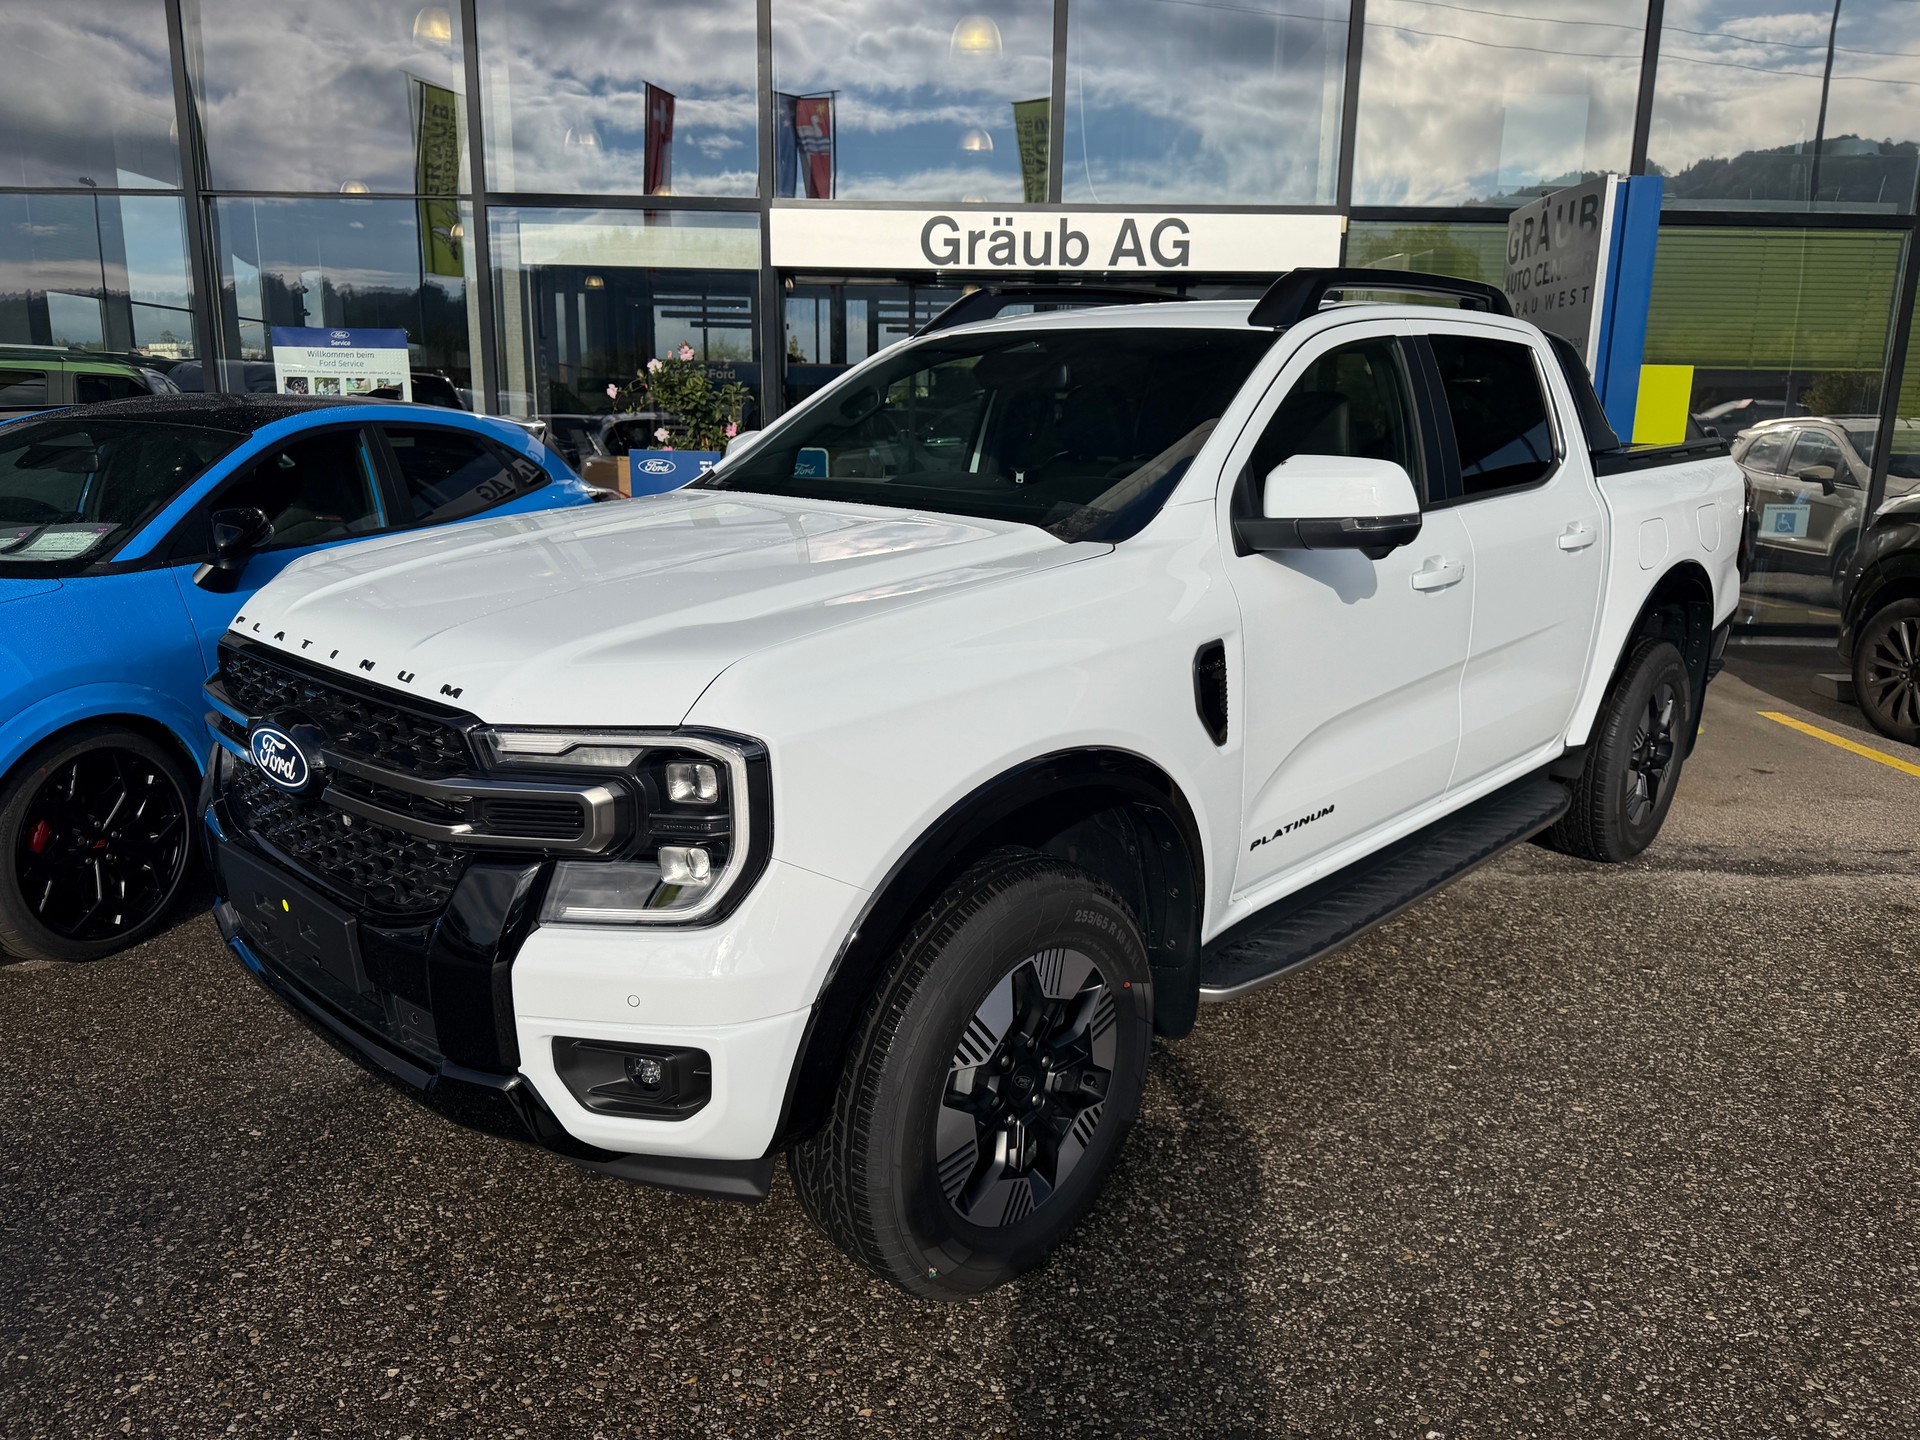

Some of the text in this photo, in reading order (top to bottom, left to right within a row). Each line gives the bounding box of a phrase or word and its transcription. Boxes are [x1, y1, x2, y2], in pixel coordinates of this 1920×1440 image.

[920, 215, 1190, 268] Gräub AG
[1508, 194, 1599, 265] GRÄUB
[1504, 267, 1531, 296] AUTO
[1514, 286, 1590, 318] RAU WEST
[307, 350, 375, 359] Willkommen beim
[338, 360, 365, 368] Service
[709, 369, 736, 380] Ford
[644, 461, 670, 473] Ford
[235, 615, 464, 700] PLATINUM
[259, 734, 297, 781] Ford
[1249, 804, 1335, 852] PLATINUM
[1074, 909, 1110, 930] 255/65
[1108, 921, 1117, 936] R
[1116, 929, 1127, 945] 18
